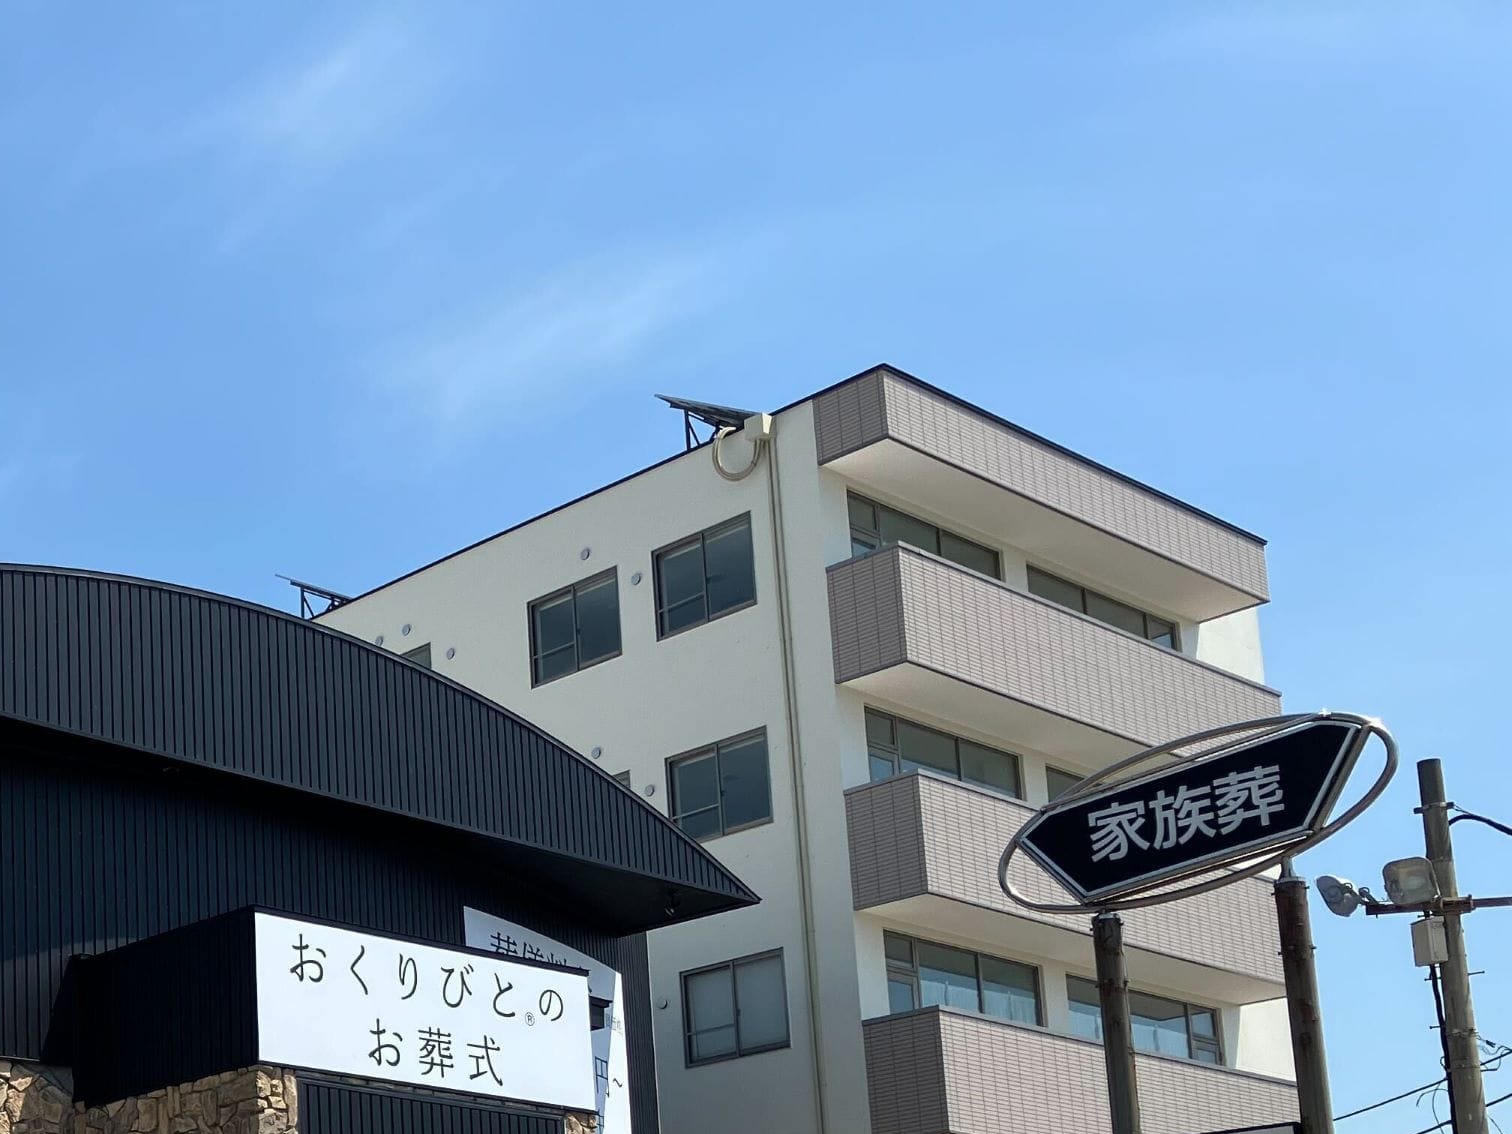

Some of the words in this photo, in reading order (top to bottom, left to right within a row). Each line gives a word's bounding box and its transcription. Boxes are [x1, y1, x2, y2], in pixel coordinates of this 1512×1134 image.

[1088, 765, 1284, 863] 家族葬
[368, 1018, 503, 1087] お葬式
